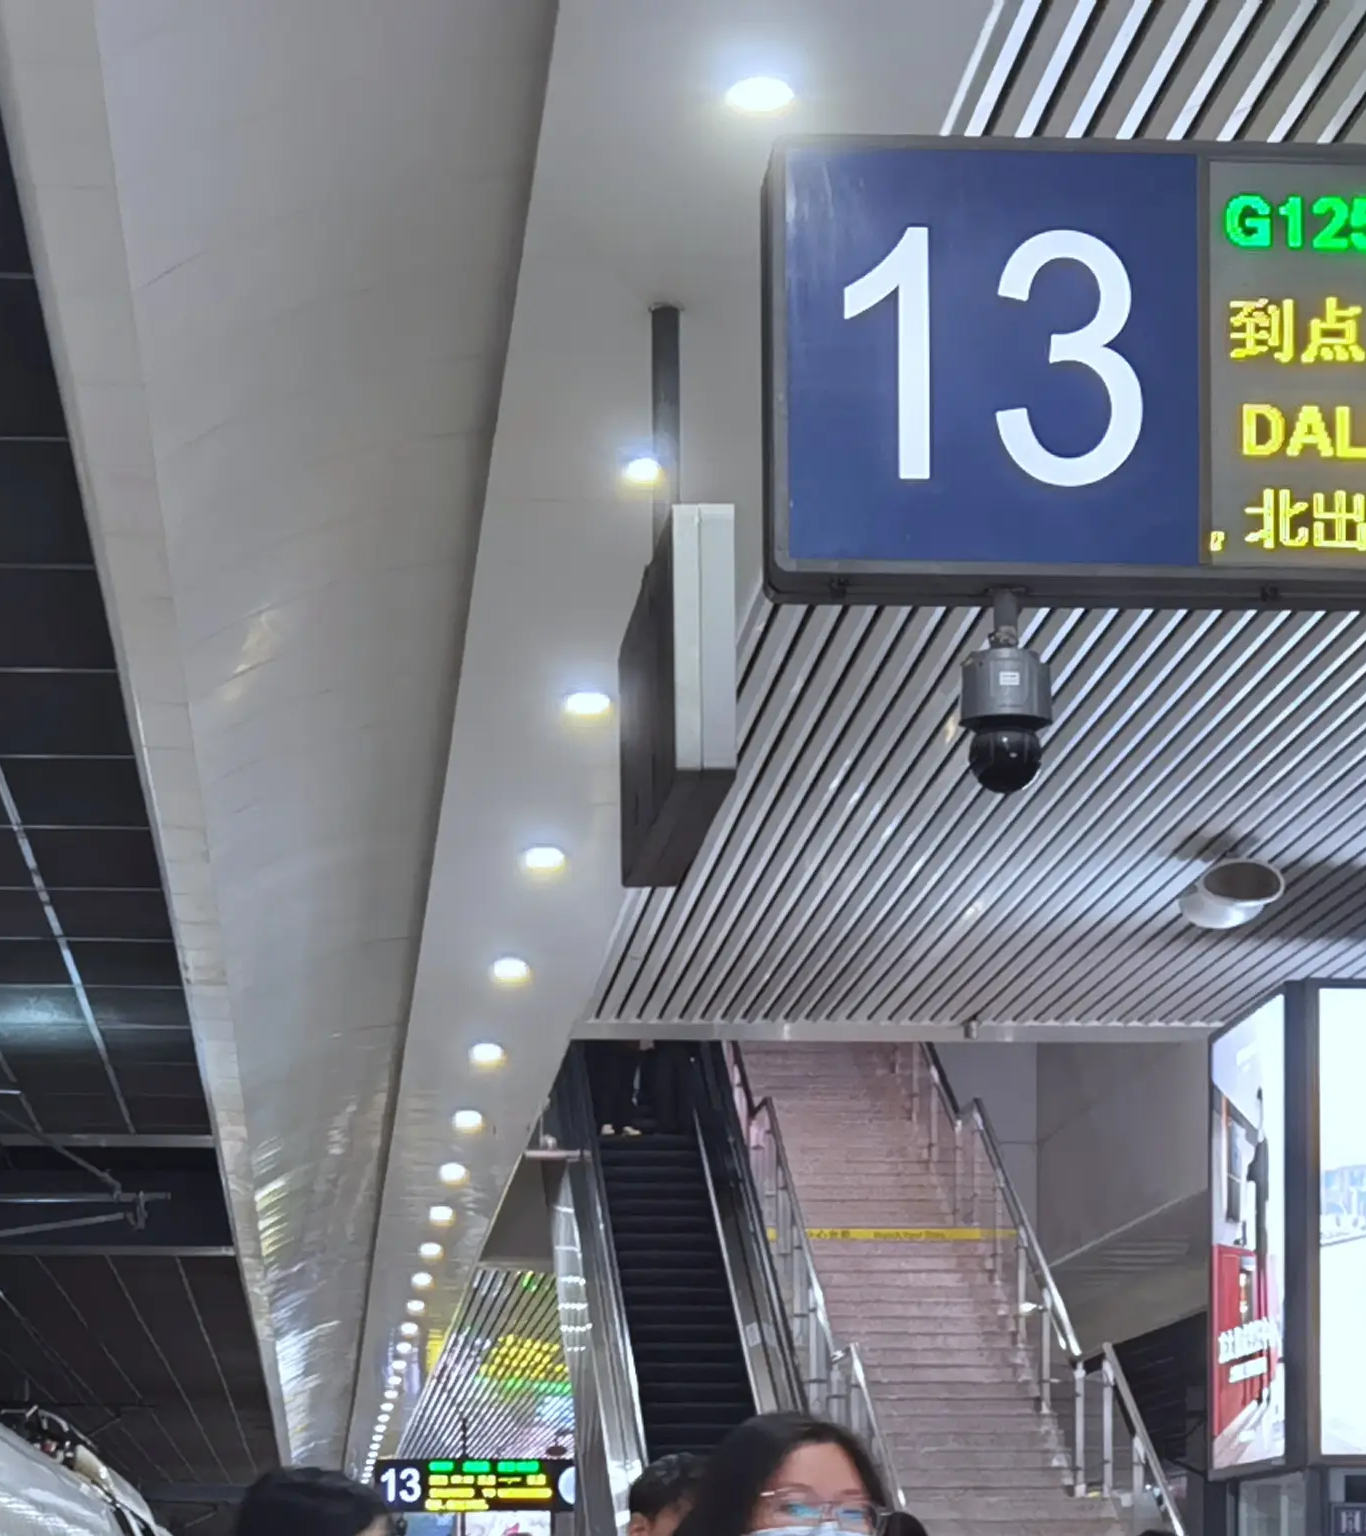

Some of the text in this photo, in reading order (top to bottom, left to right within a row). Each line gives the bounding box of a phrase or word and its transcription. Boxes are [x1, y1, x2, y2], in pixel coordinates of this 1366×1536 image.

[842, 225, 1144, 488] 13
[1230, 297, 1366, 364] 到点
[380, 1467, 423, 1503] 13
